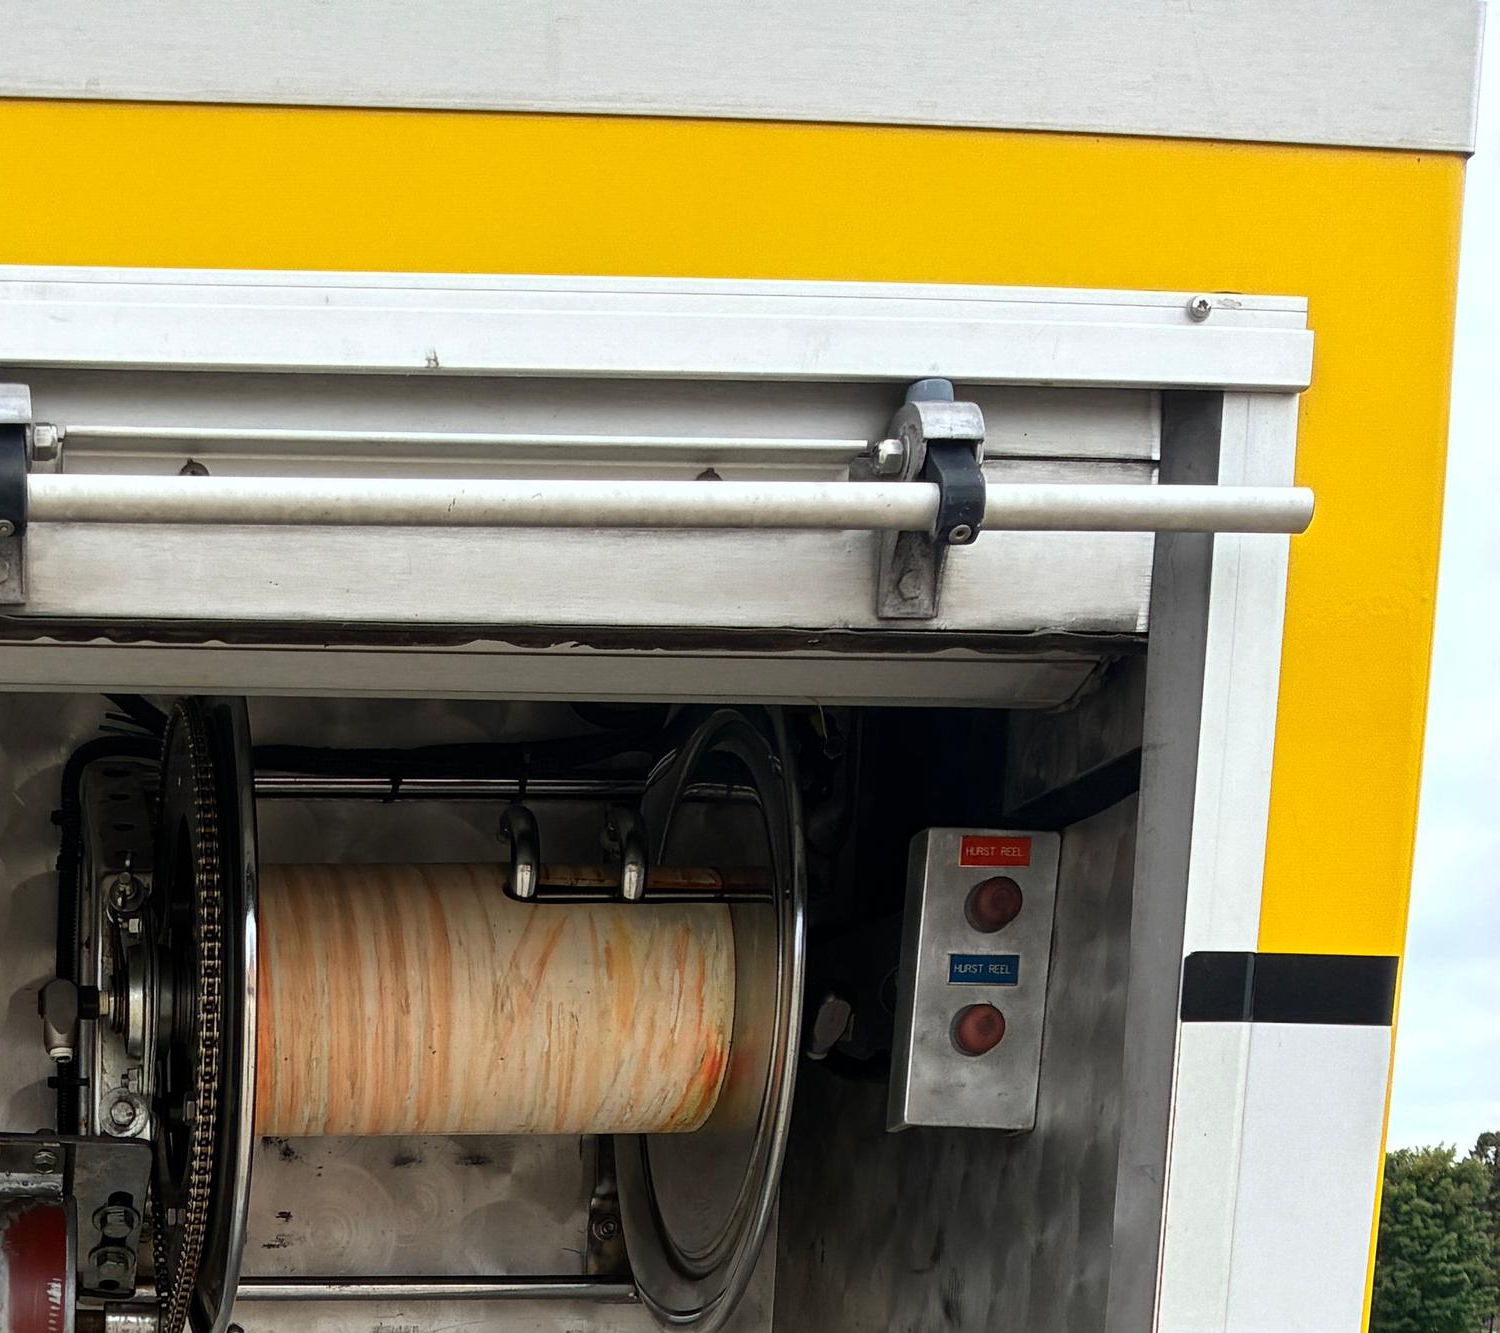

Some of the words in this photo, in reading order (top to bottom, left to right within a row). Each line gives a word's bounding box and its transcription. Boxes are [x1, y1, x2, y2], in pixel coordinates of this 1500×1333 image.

[965, 846, 995, 856] HURST
[1000, 847, 1024, 857] REEL
[954, 963, 984, 973] HURST
[988, 964, 1012, 974] REEL
